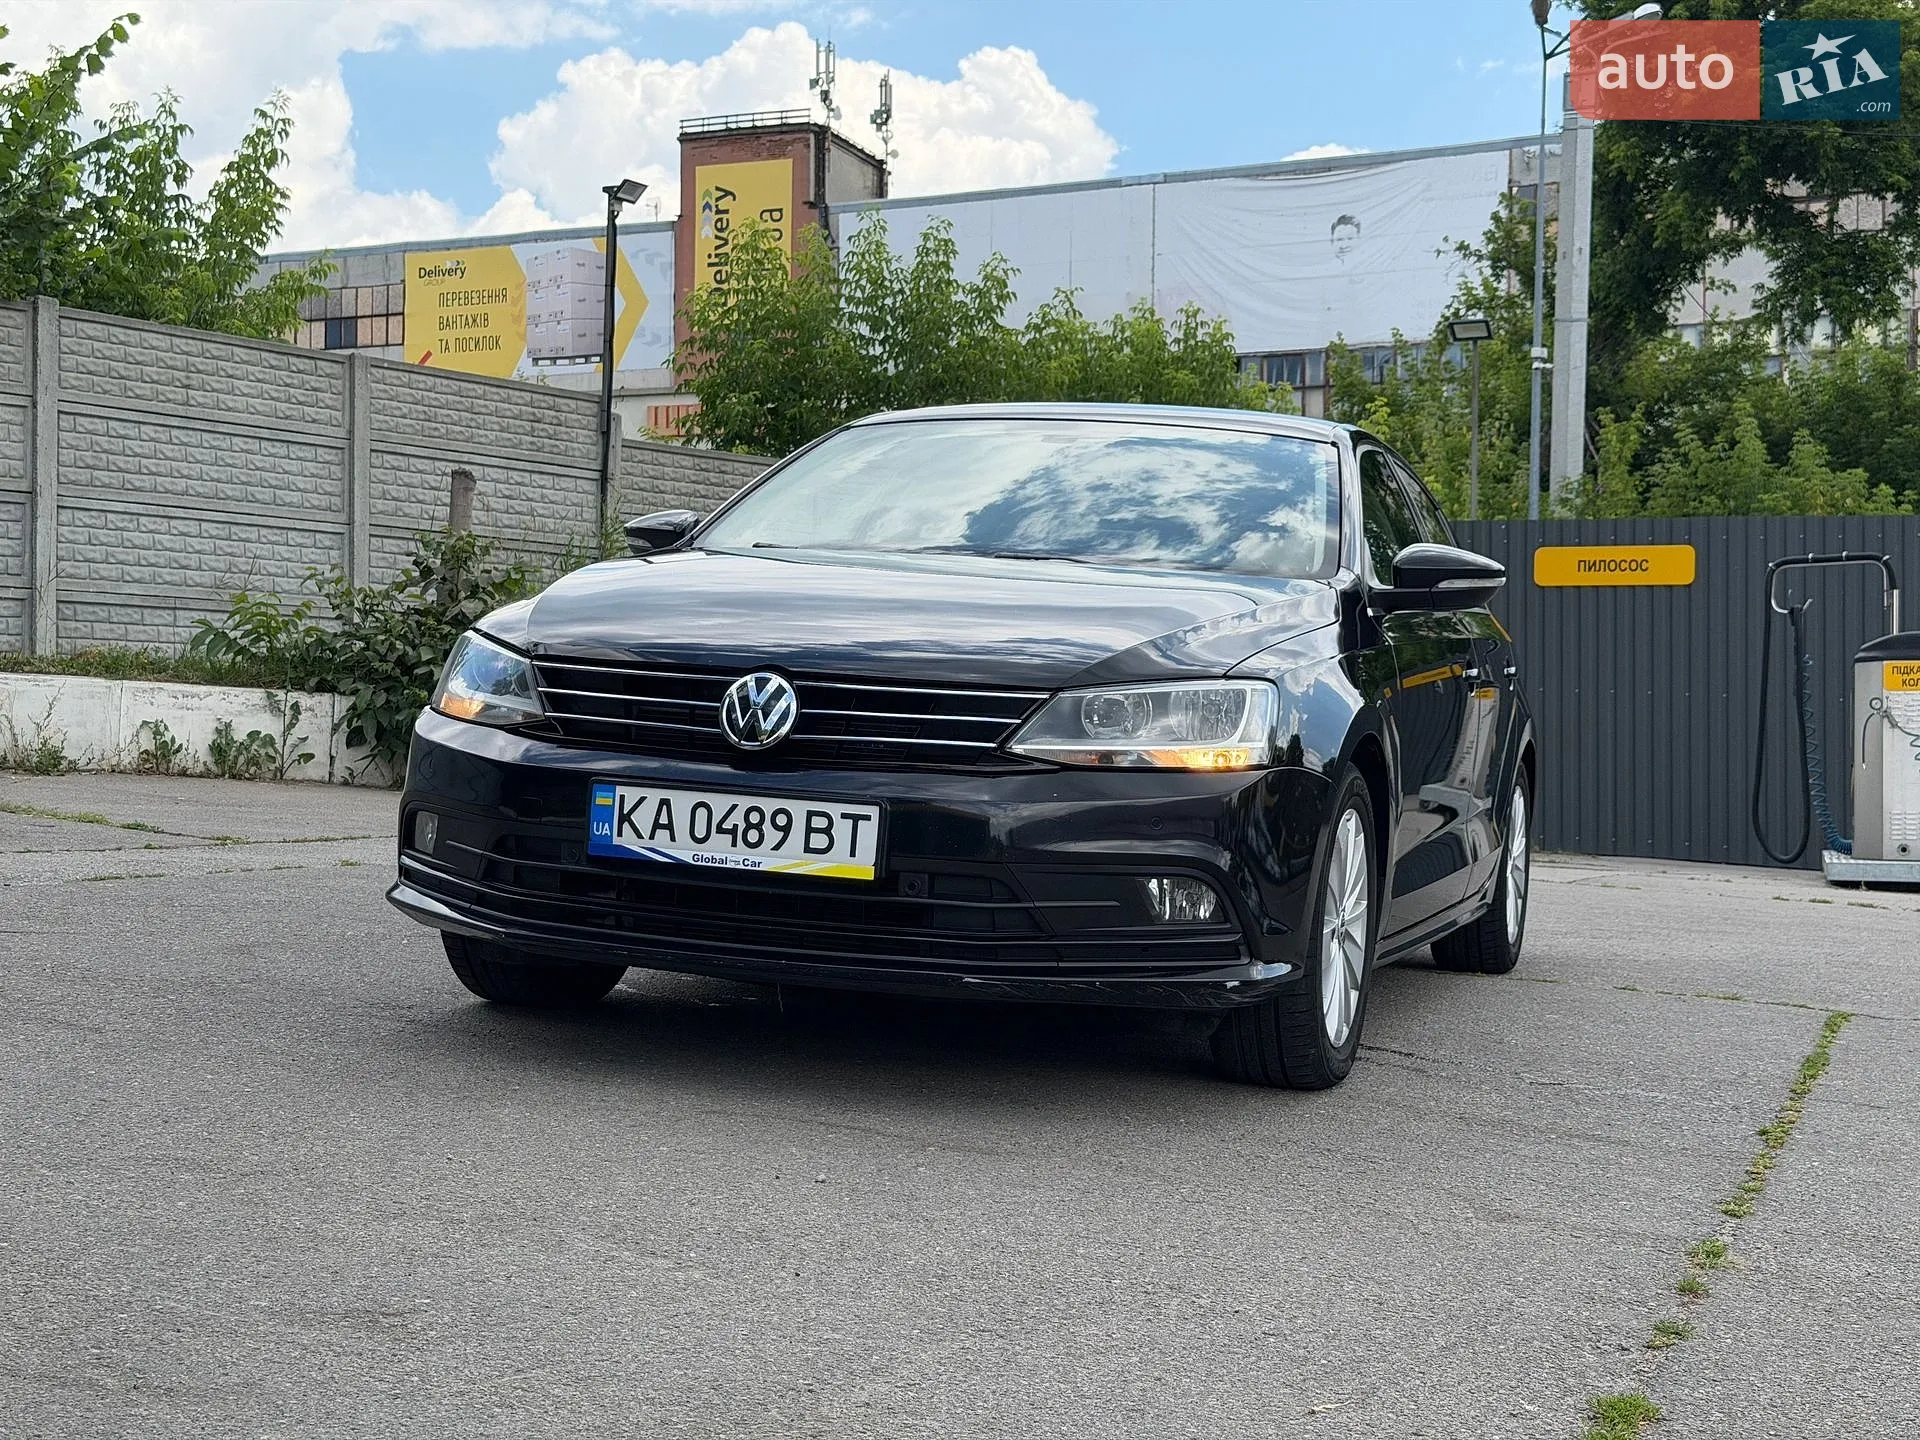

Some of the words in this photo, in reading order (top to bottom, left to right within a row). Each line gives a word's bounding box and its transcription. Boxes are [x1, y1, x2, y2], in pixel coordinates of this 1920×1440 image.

[418, 265, 467, 279] Delivery
[438, 288, 508, 308] ПЕРЕВЕЗЕННЯ
[438, 313, 489, 331] ВАНТАЖІВ
[438, 339, 451, 354] ТА
[454, 335, 502, 353] ПОСИЛОК
[1577, 559, 1649, 572] ПИЛОСОС
[593, 821, 611, 836] UA
[616, 794, 676, 842] KA
[689, 800, 793, 851] 0489
[803, 810, 872, 858] BT
[692, 853, 728, 865] Global
[742, 857, 763, 868] Car
